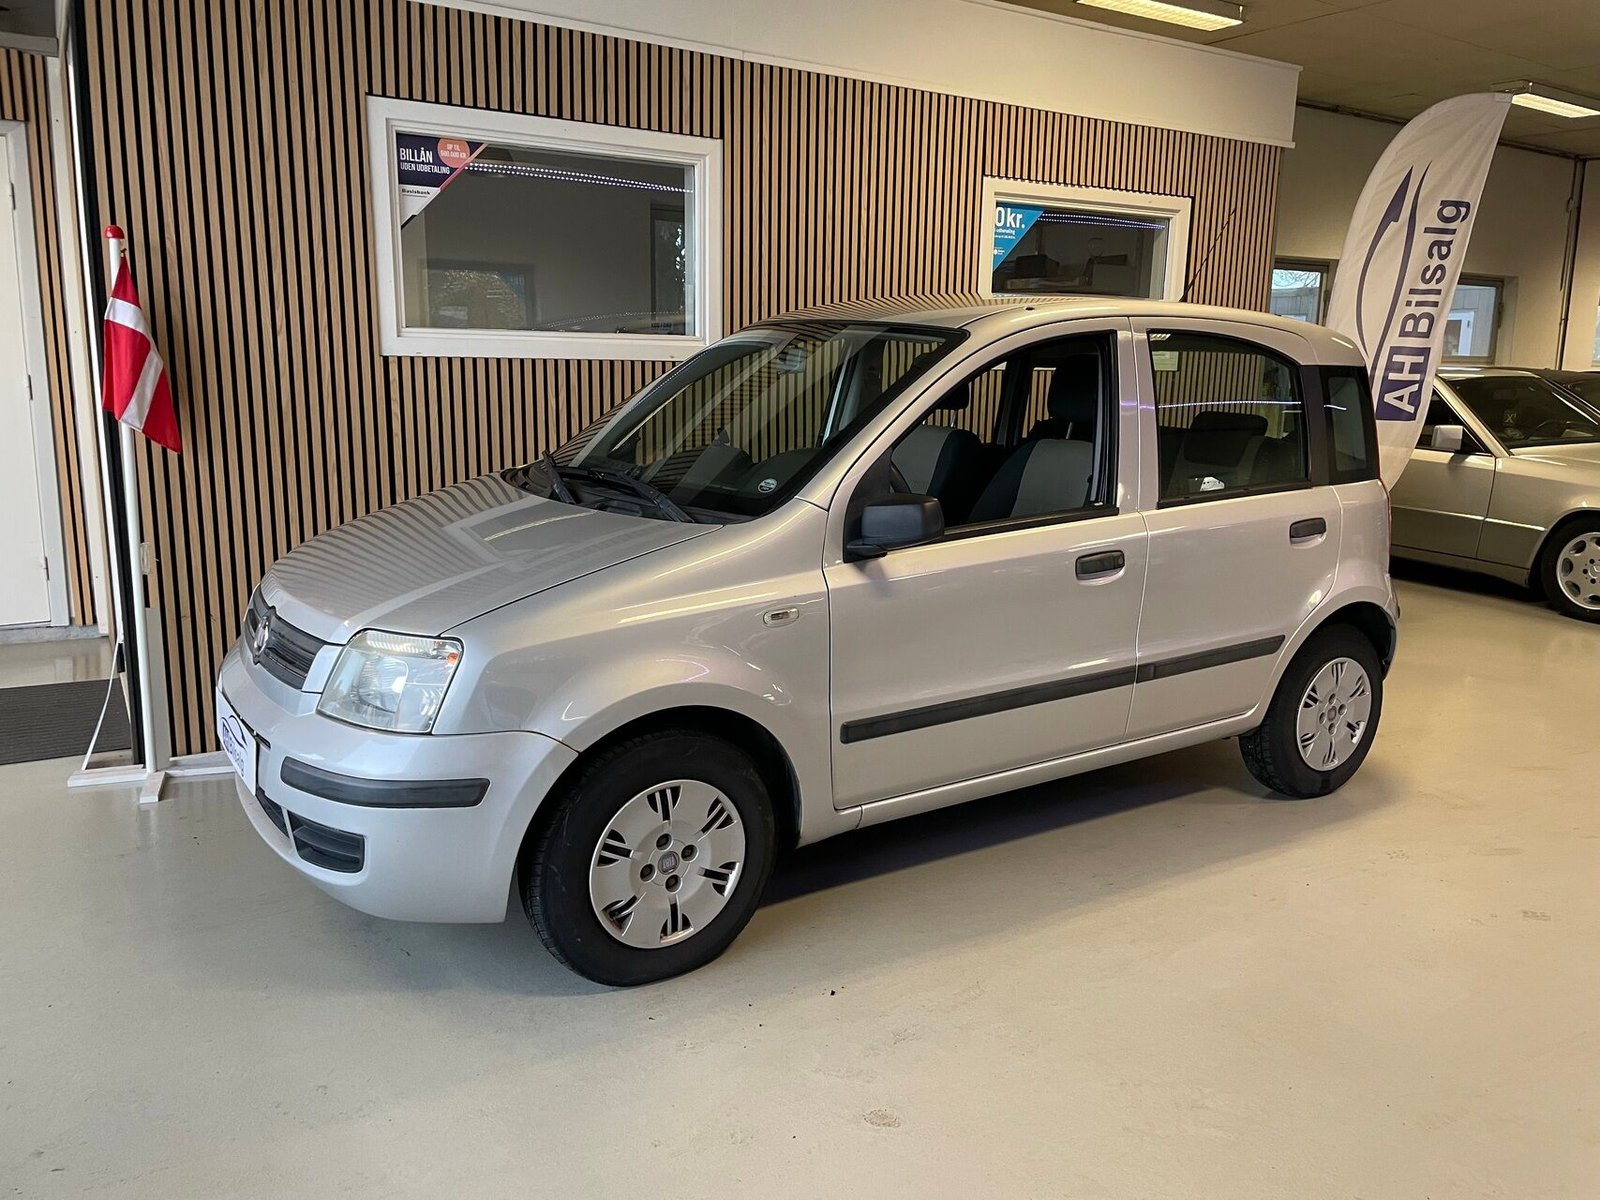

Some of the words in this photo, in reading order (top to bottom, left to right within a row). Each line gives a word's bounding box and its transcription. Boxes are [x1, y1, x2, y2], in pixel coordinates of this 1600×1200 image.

[400, 147, 432, 163] BILLÅN
[400, 162, 415, 170] UDEN
[416, 164, 450, 174] UDBETALING
[1006, 208, 1026, 228] kr.
[1399, 200, 1470, 338] Bilsalg
[1383, 354, 1424, 414] AH
